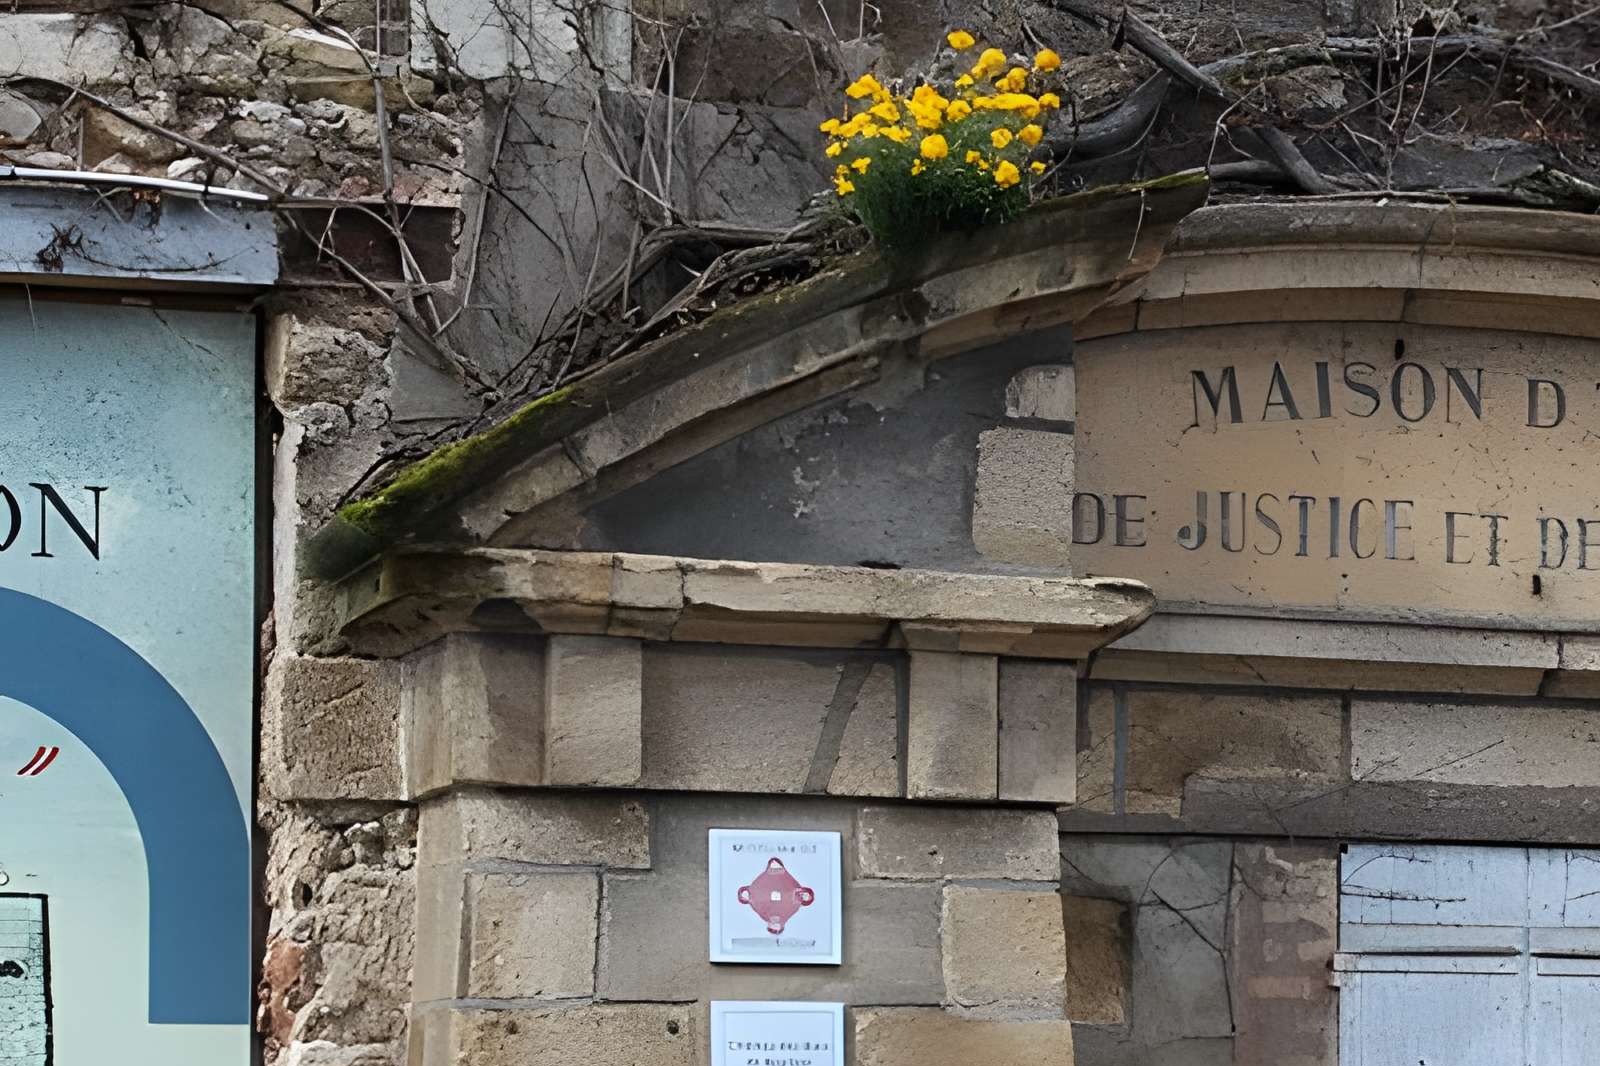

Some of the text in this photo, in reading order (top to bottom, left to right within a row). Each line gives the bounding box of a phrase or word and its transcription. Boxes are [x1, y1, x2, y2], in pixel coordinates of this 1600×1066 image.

[1185, 360, 1484, 431] MAISON
[1072, 491, 1147, 547] DE
[1176, 490, 1416, 562] JUSTICE
[1444, 511, 1509, 567] ET
